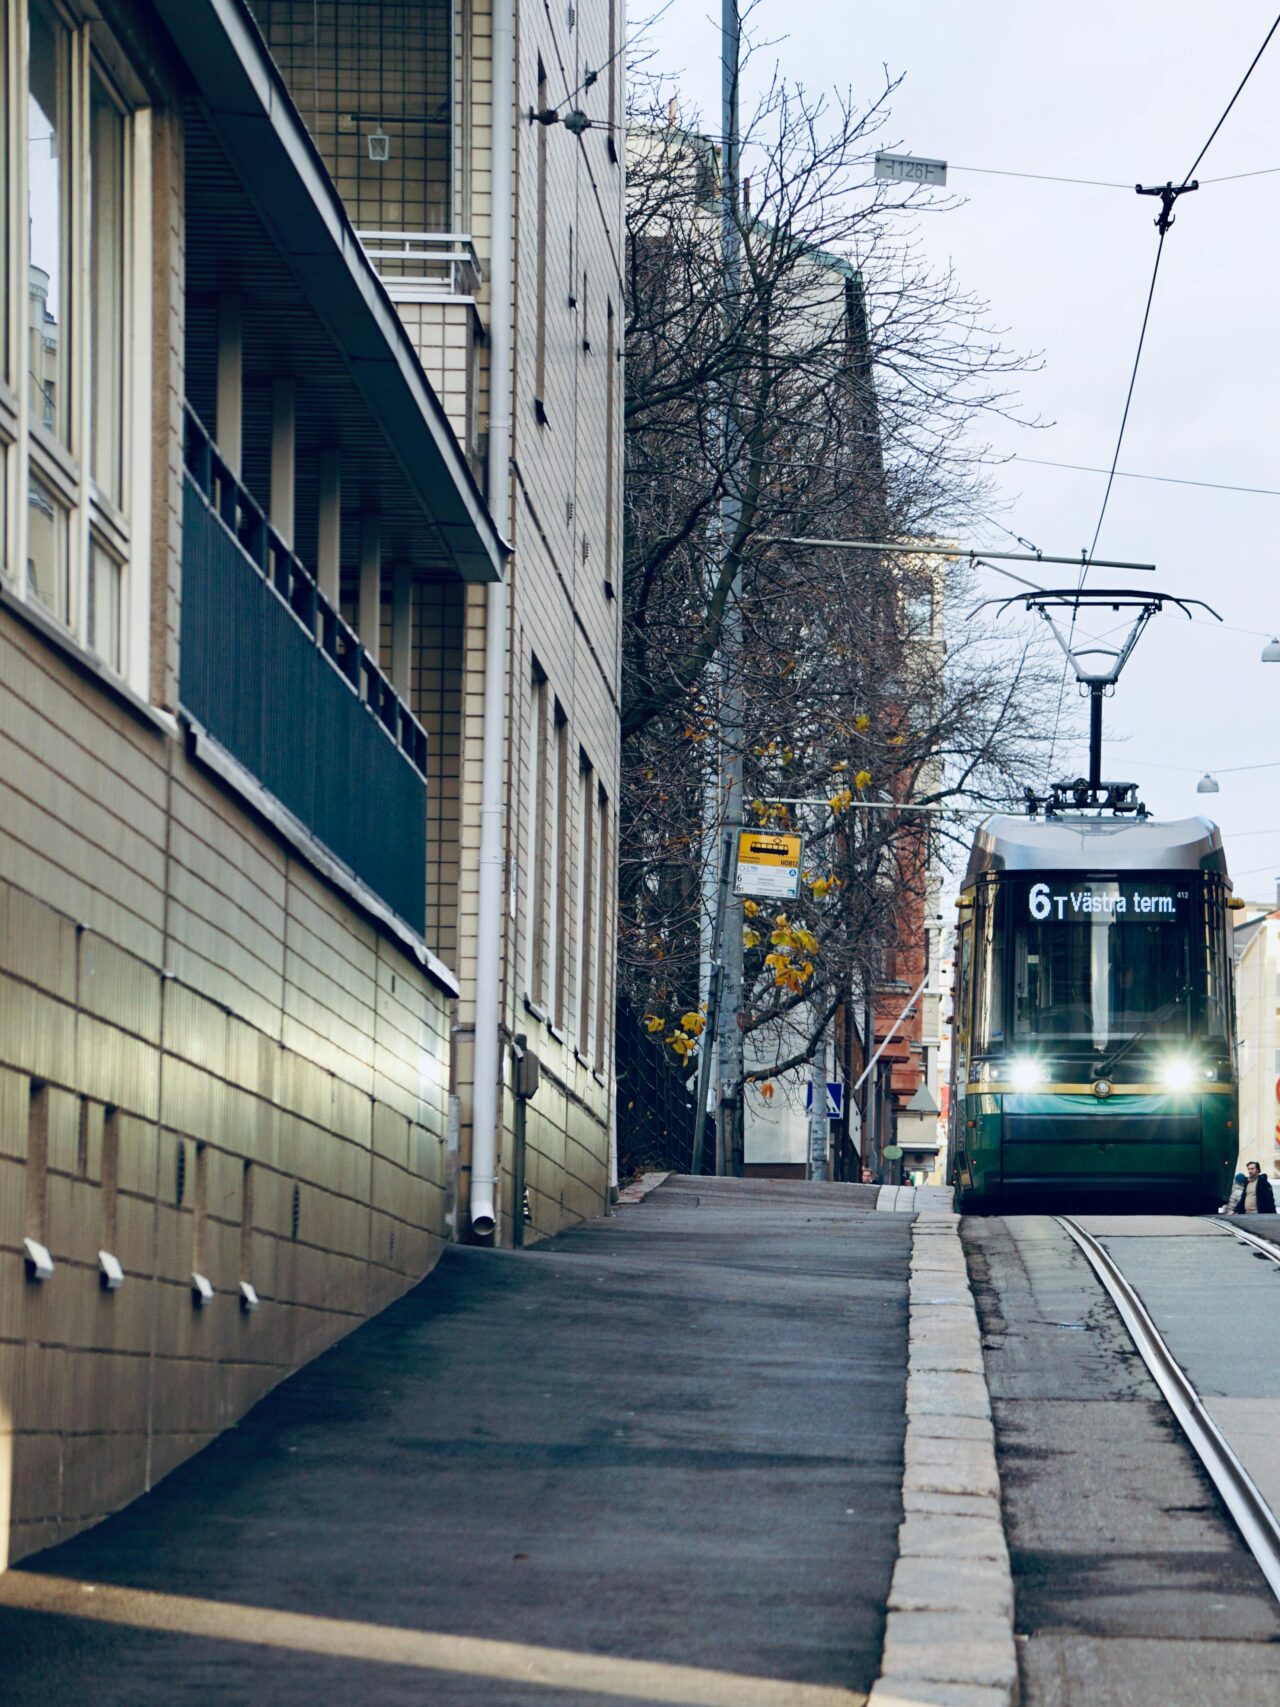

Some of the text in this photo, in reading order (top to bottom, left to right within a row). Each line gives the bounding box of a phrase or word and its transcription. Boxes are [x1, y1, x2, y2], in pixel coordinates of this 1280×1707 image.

[1176, 891, 1189, 899] 412
[1070, 892, 1127, 913] Västra
[1133, 892, 1176, 913] term.
